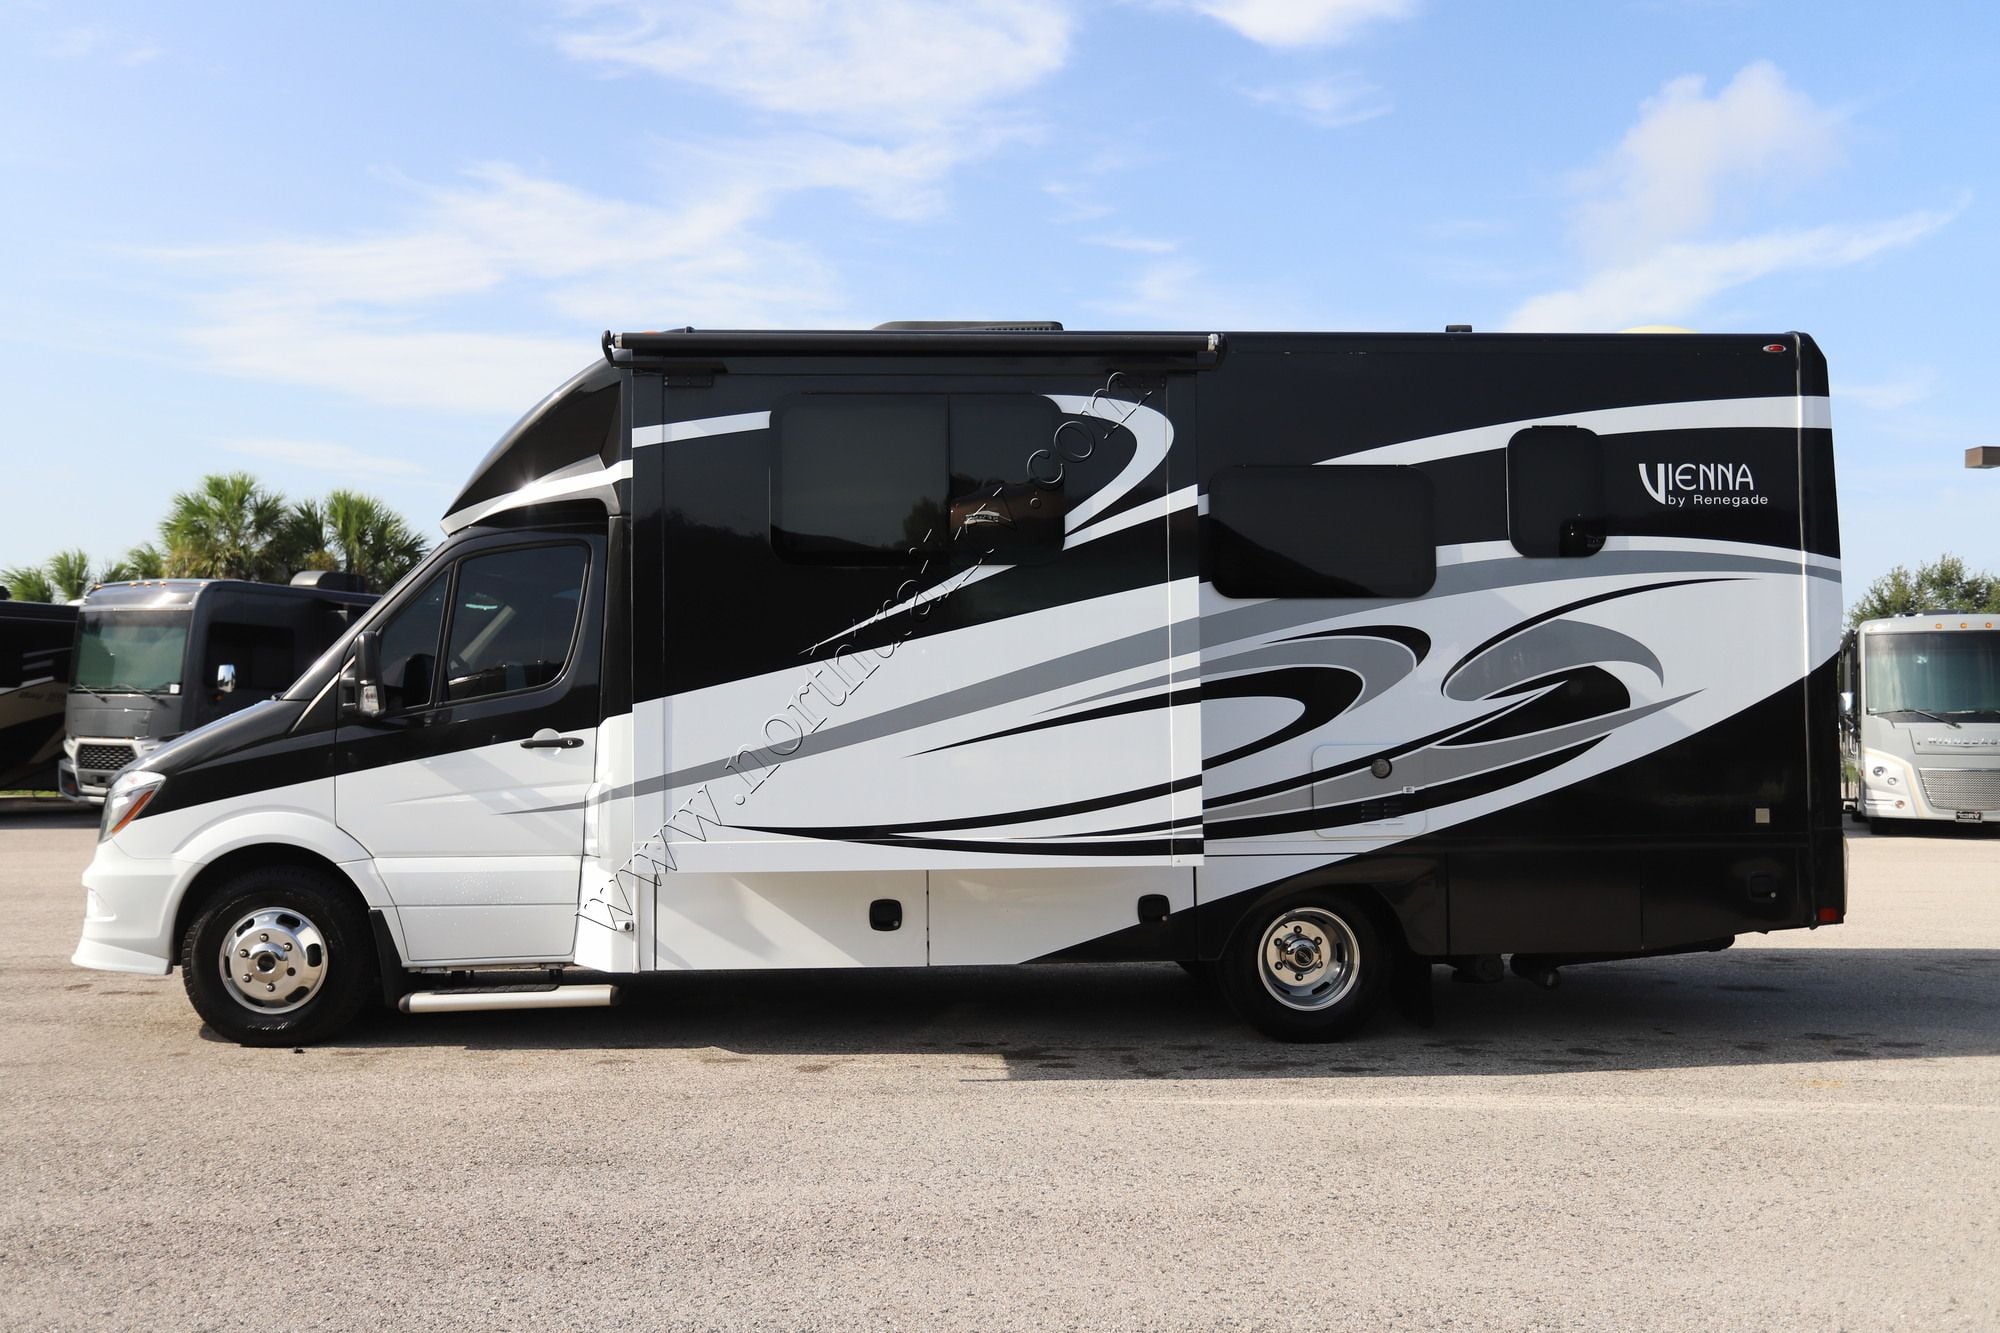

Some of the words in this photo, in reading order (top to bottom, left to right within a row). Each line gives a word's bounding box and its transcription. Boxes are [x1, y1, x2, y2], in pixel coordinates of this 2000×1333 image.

[1638, 463, 1754, 504] VIENNA
[1667, 495, 1686, 508] by
[1693, 494, 1769, 508] Renegade
